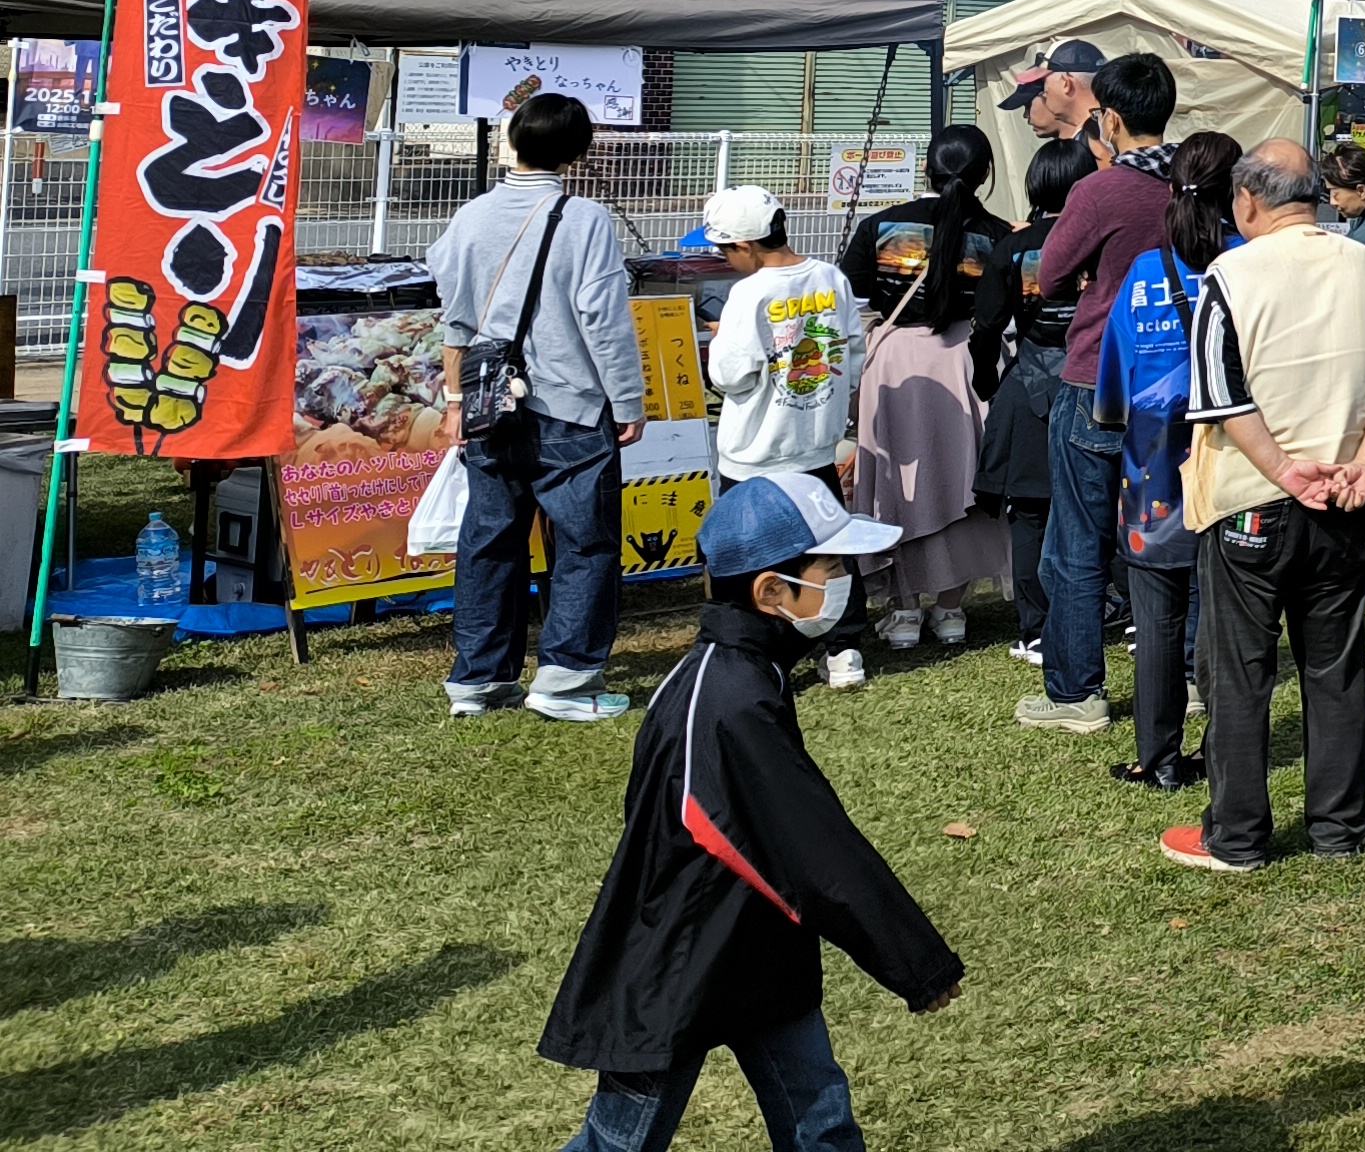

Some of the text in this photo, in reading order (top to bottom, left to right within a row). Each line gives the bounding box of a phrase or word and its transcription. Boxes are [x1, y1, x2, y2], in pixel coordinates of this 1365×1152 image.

[504, 55, 560, 73] やきとり
[553, 73, 622, 93] なっちゃん
[24, 87, 98, 104] 2025.1
[604, 96, 633, 120] 感謝
[767, 289, 837, 323] SPAM
[670, 337, 690, 386] つくね
[679, 400, 695, 410] 250
